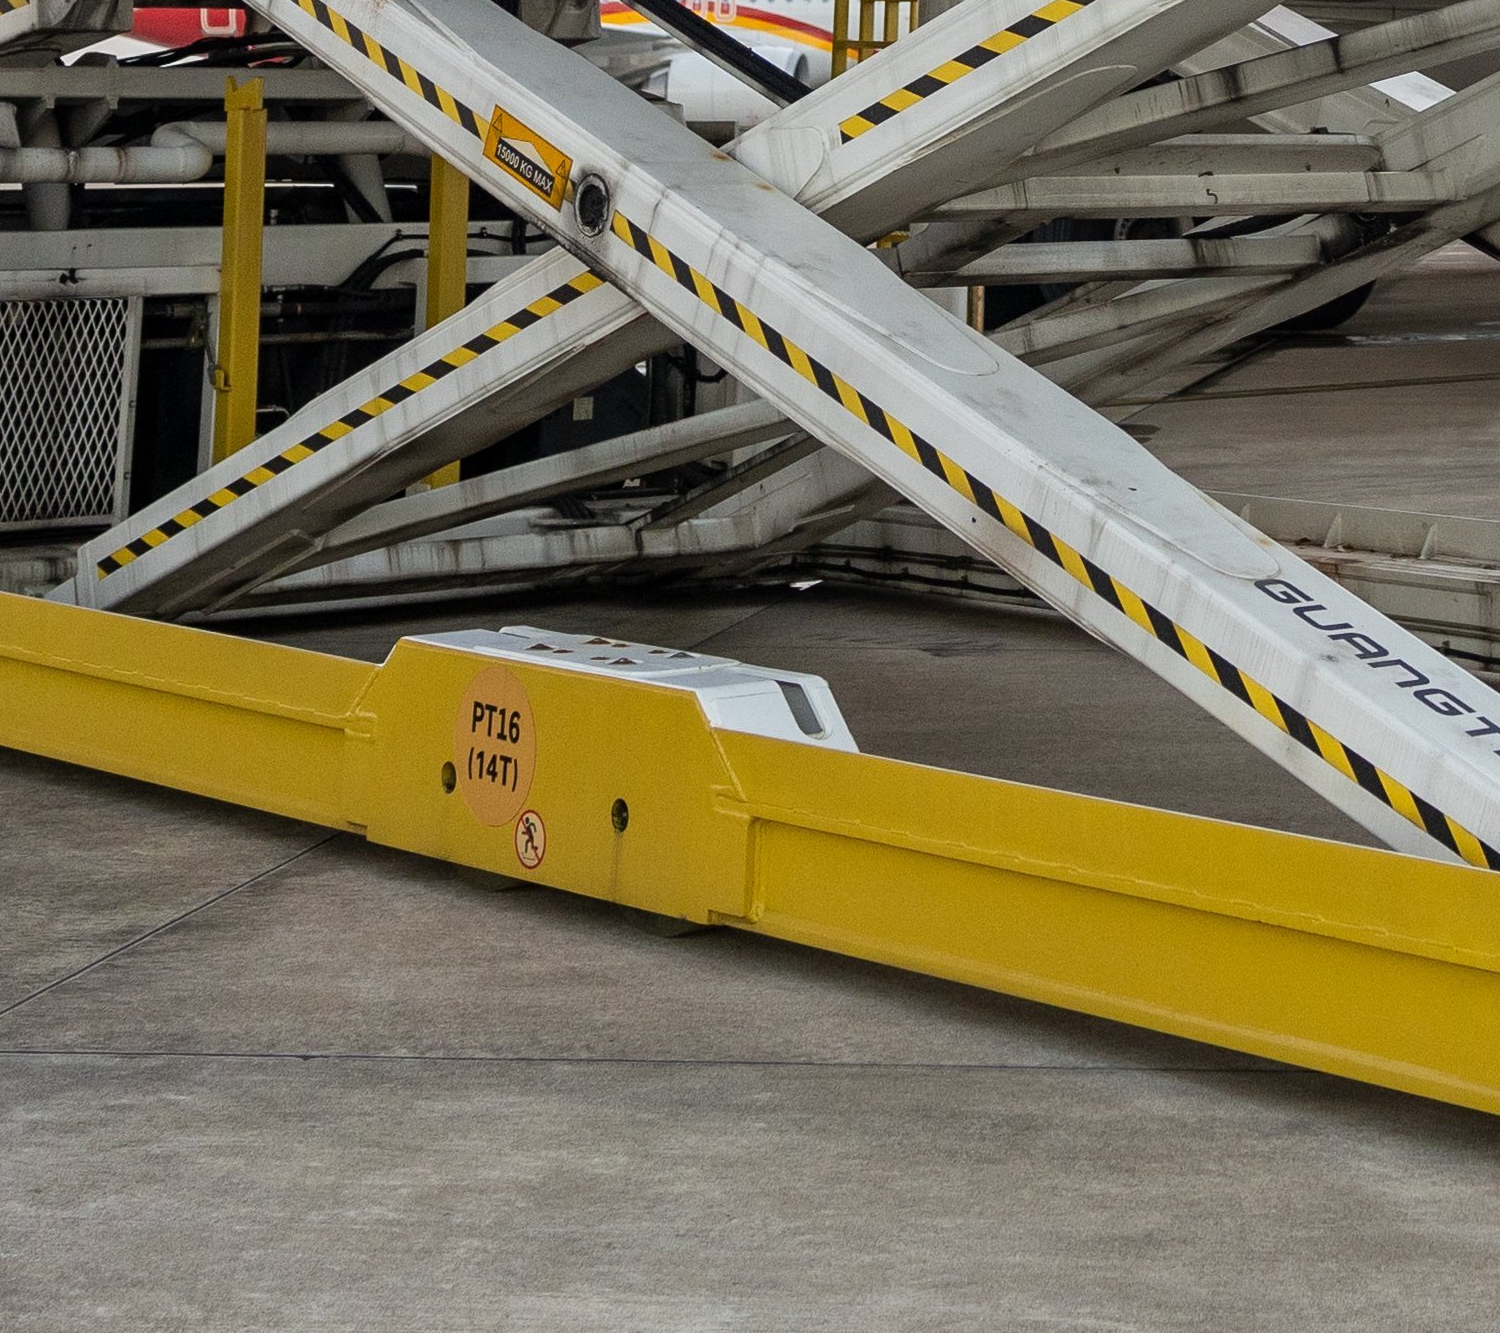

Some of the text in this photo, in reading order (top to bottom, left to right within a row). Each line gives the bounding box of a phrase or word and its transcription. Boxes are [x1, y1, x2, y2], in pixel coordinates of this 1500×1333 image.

[497, 143, 553, 193] 15000 KG MAX
[471, 701, 521, 745] PT16
[468, 747, 519, 793] (14T)
